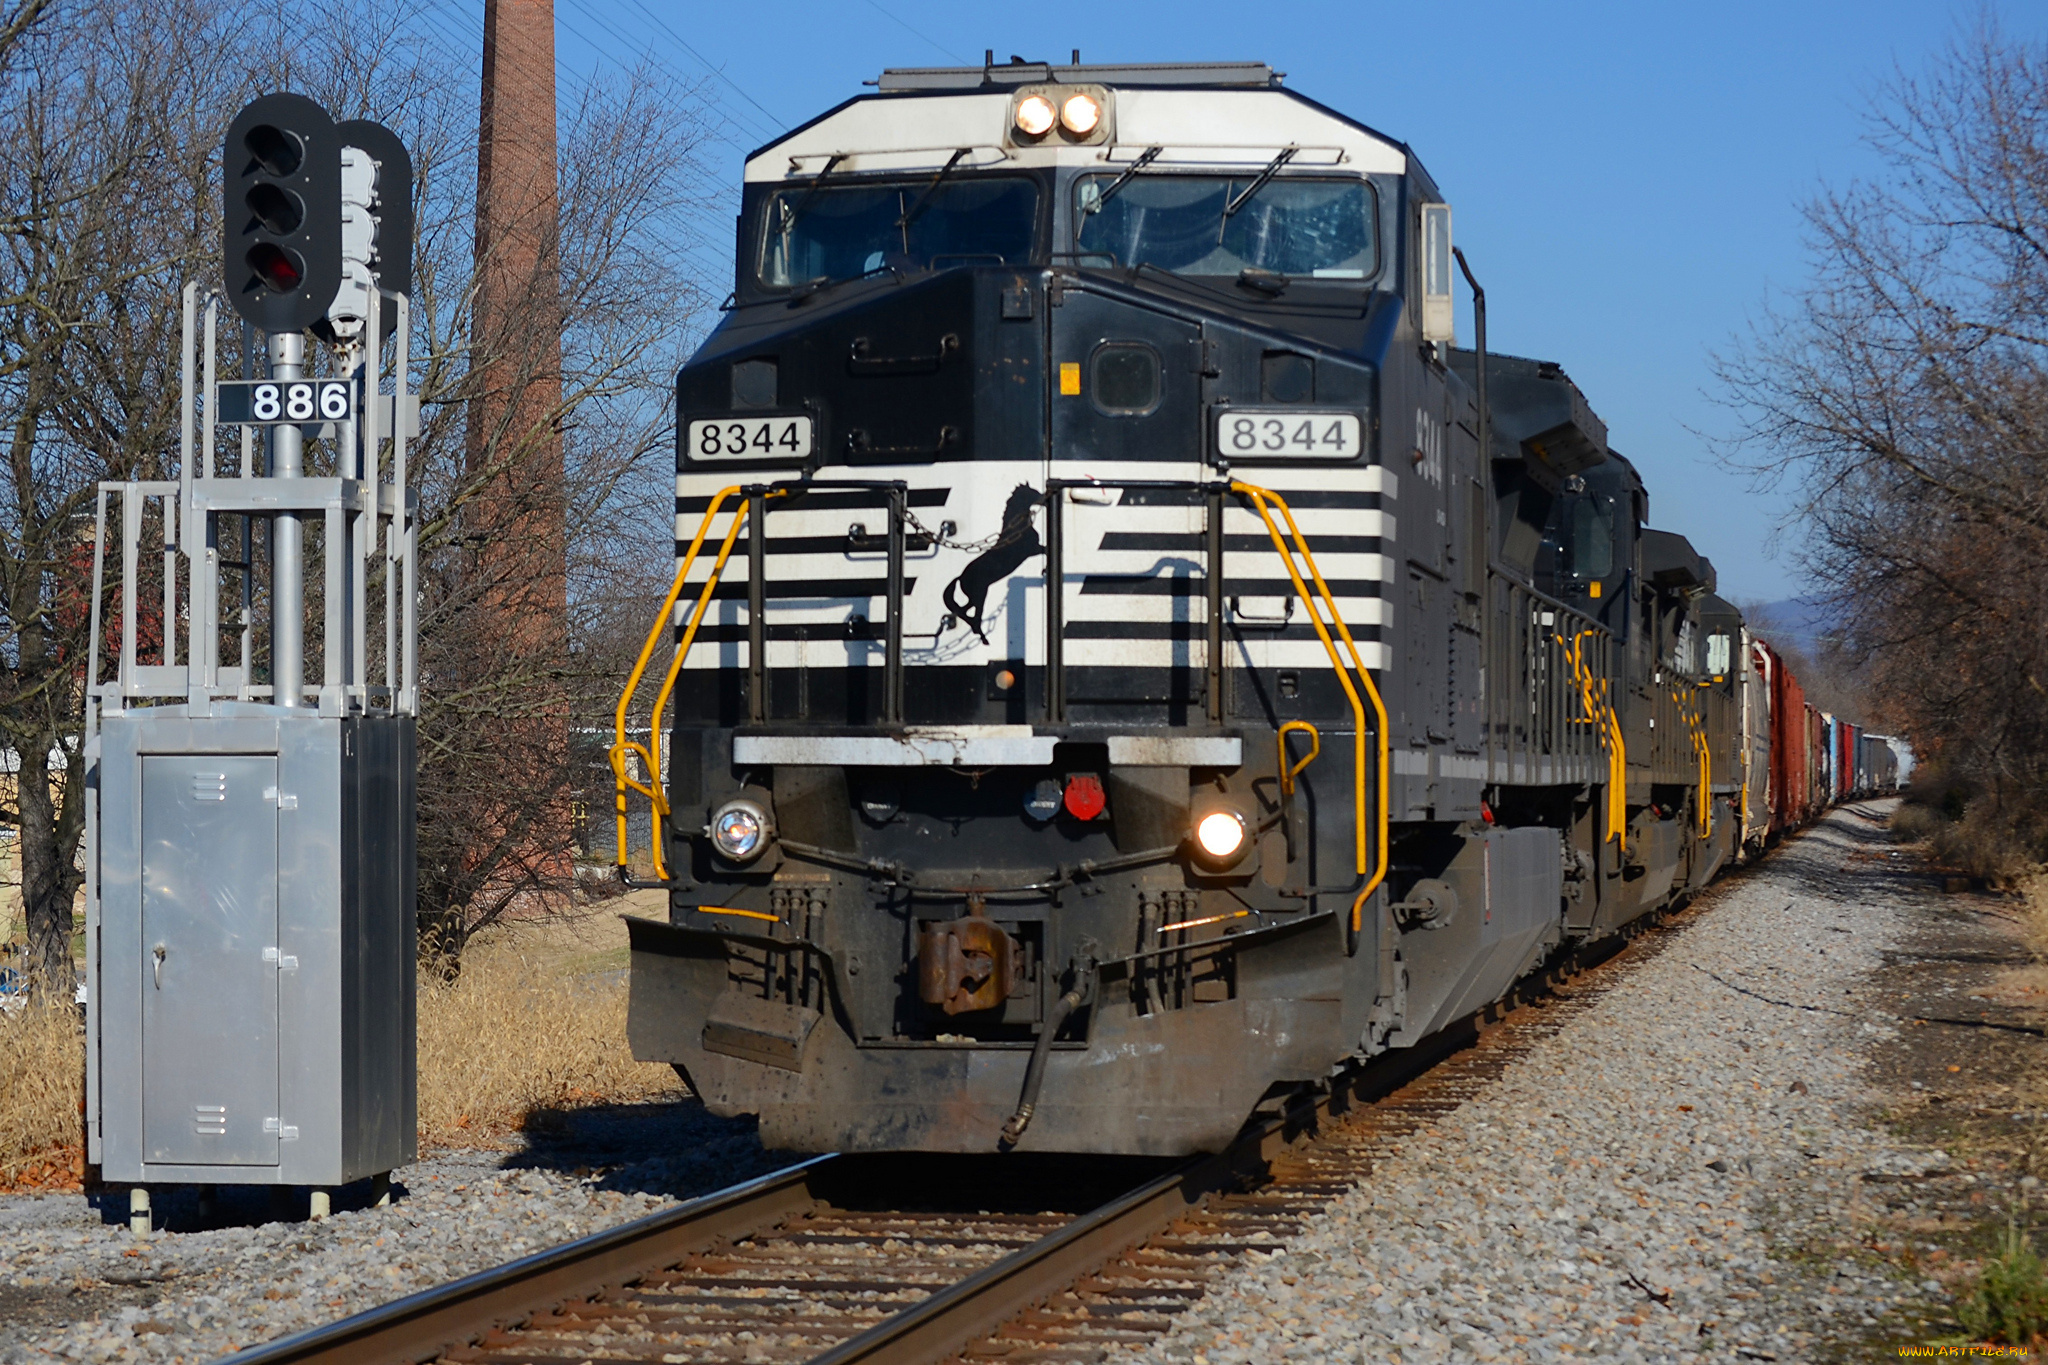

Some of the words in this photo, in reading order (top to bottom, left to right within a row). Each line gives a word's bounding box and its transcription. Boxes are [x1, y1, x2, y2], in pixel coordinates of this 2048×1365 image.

[254, 383, 347, 420] 886
[701, 422, 800, 455] 8344
[1232, 418, 1347, 451] 8344
